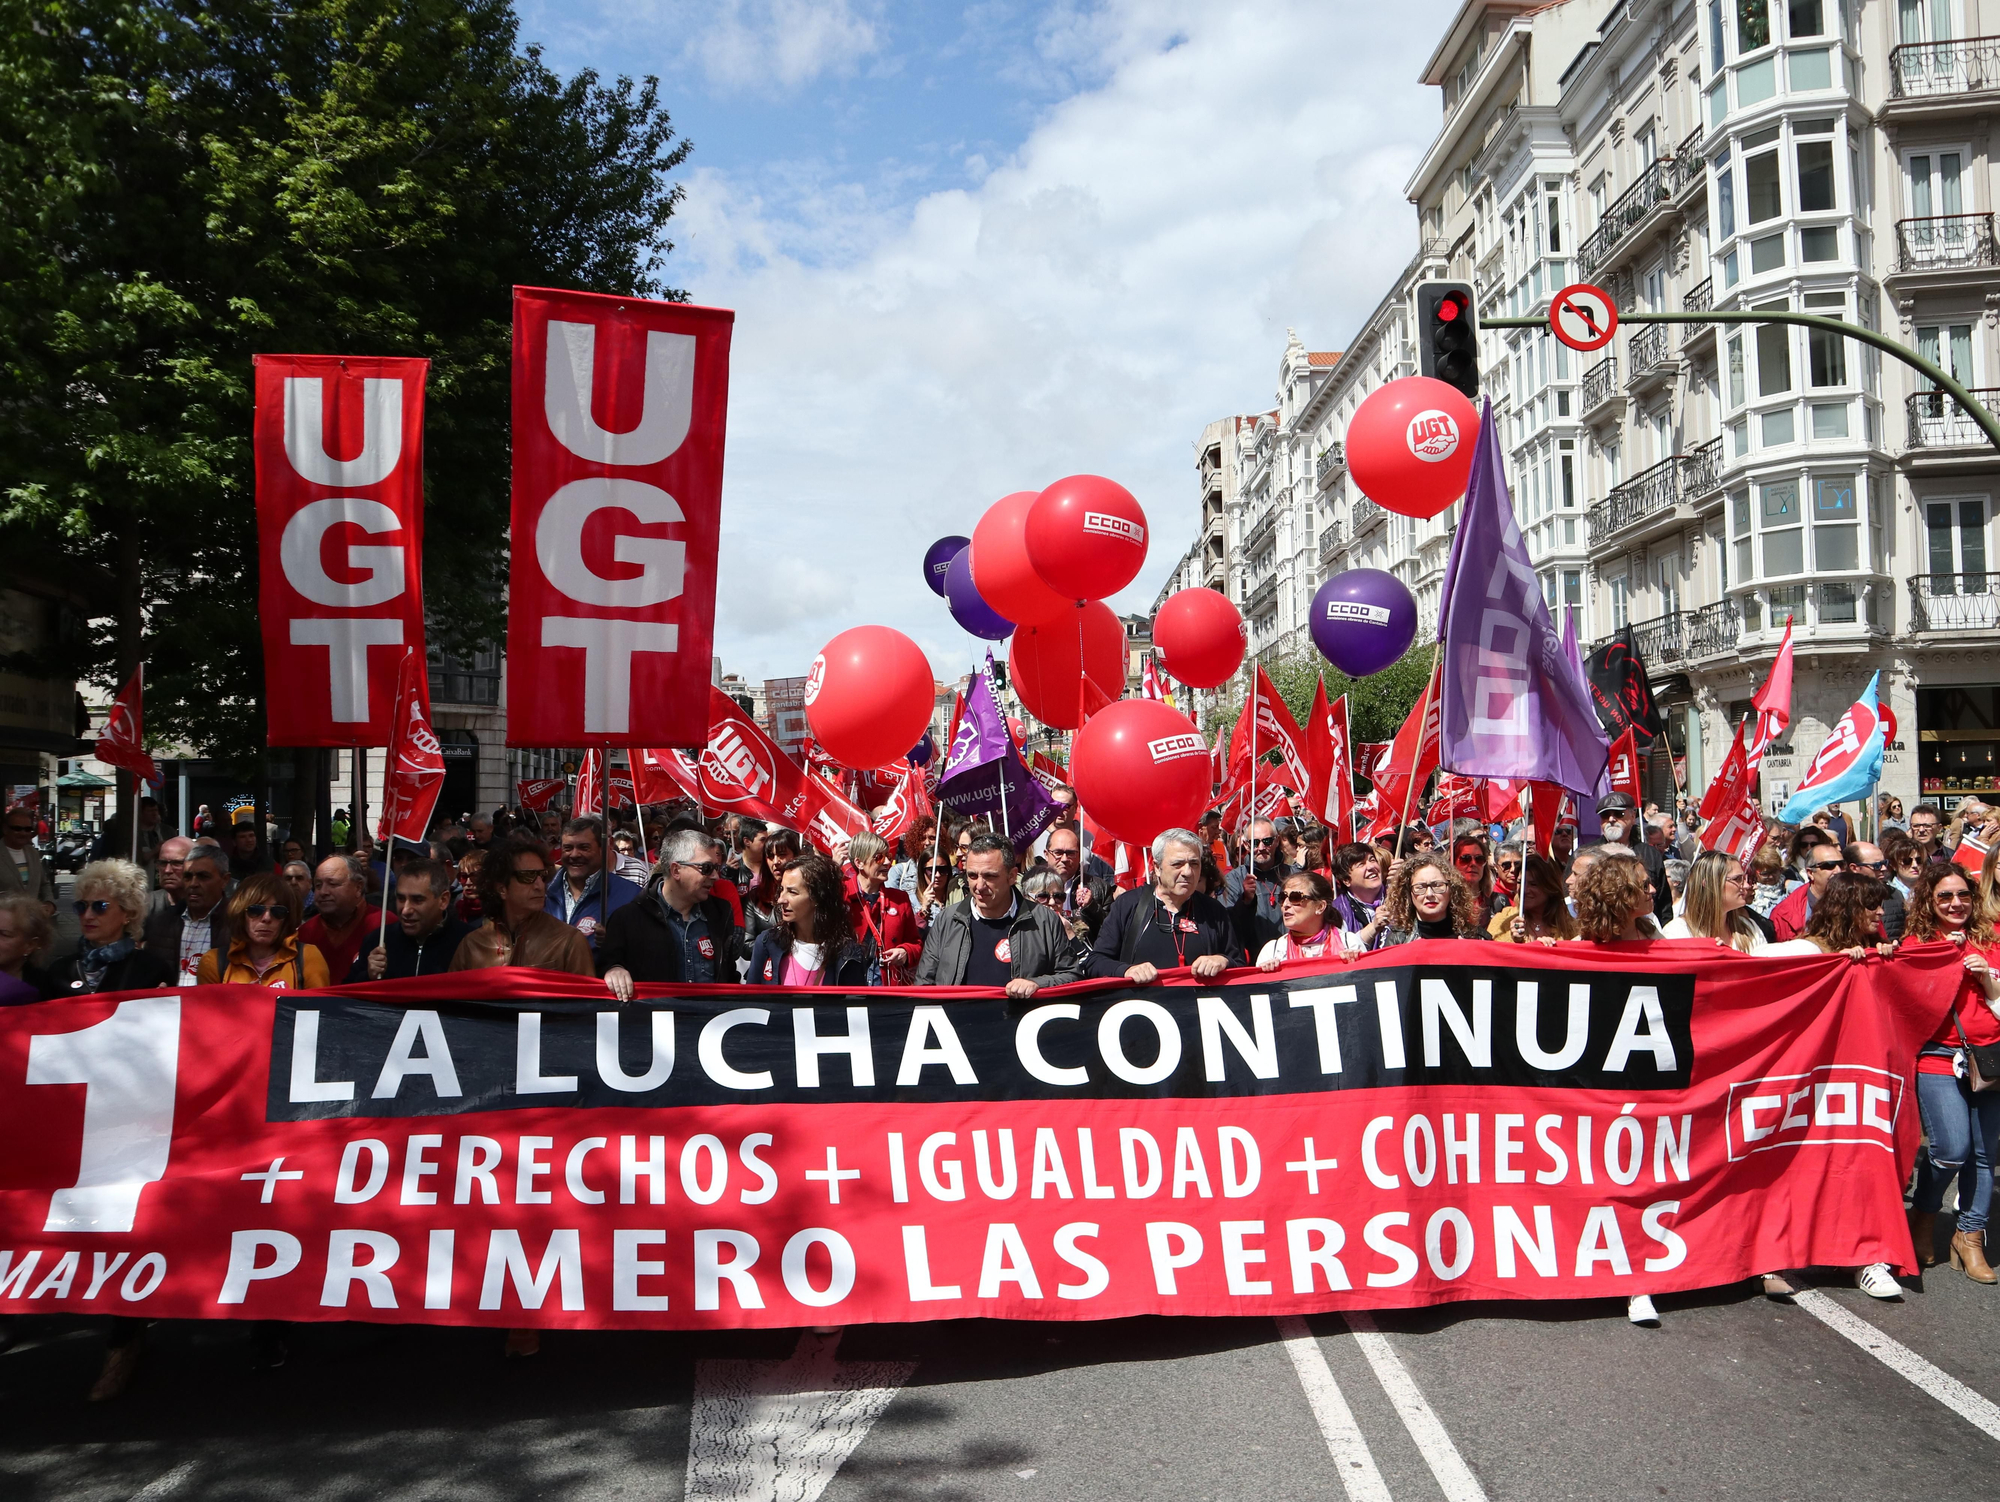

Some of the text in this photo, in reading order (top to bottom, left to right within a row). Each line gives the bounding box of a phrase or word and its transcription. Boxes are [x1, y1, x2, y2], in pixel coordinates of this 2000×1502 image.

[1412, 415, 1452, 444] UGT
[535, 319, 697, 734] UGT
[1088, 515, 1131, 533] CCOO
[279, 376, 406, 724] UGT
[1330, 604, 1370, 616] CCOO
[440, 747, 472, 756] CaixaBank
[708, 725, 771, 795] UGT
[1153, 737, 1196, 755] CCOO
[1766, 758, 1793, 769] CANTABRIA
[942, 781, 1016, 807] ww.ugt.es
[578, 917, 596, 928] UGT
[698, 938, 714, 951] UGT
[289, 978, 1678, 1103] LA LUCHA CONTINUA
[25, 995, 181, 1233] 1
[240, 1102, 1693, 1205] + DERECHOS + IGUALDAD + COHESIÓN
[217, 1200, 1687, 1311] PRIMERO LAS PERSONAS
[0, 1250, 168, 1302] MAYO
